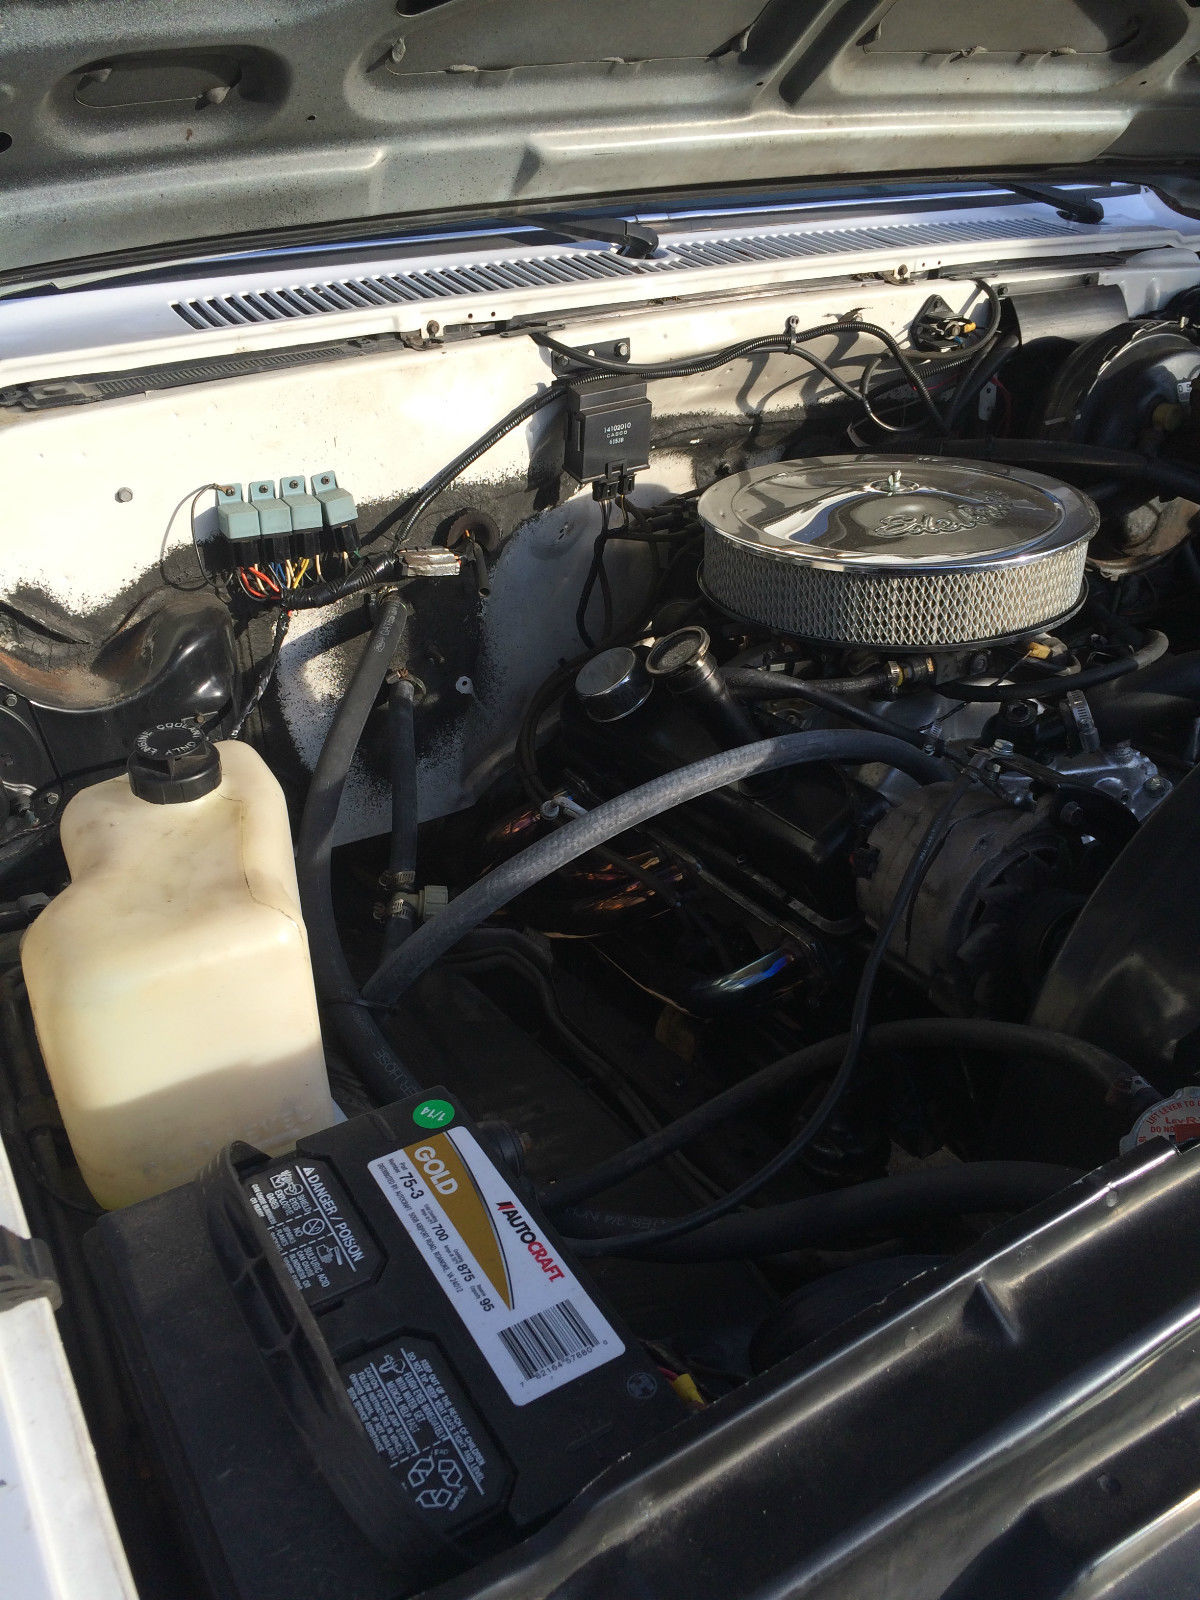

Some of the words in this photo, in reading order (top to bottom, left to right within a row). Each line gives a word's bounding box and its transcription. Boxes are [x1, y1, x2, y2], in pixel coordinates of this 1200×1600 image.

[165, 741, 196, 756] ONLY
[420, 1106, 446, 1122] 1/14
[412, 1145, 460, 1196] GOLD
[399, 1172, 425, 1199] 75-3
[307, 1174, 338, 1215] DANGER
[334, 1222, 364, 1261] POISON
[431, 1224, 449, 1241] 700
[502, 1206, 564, 1282] AUTOCRAFT
[456, 1263, 475, 1282] 875
[478, 1298, 495, 1311] 95
